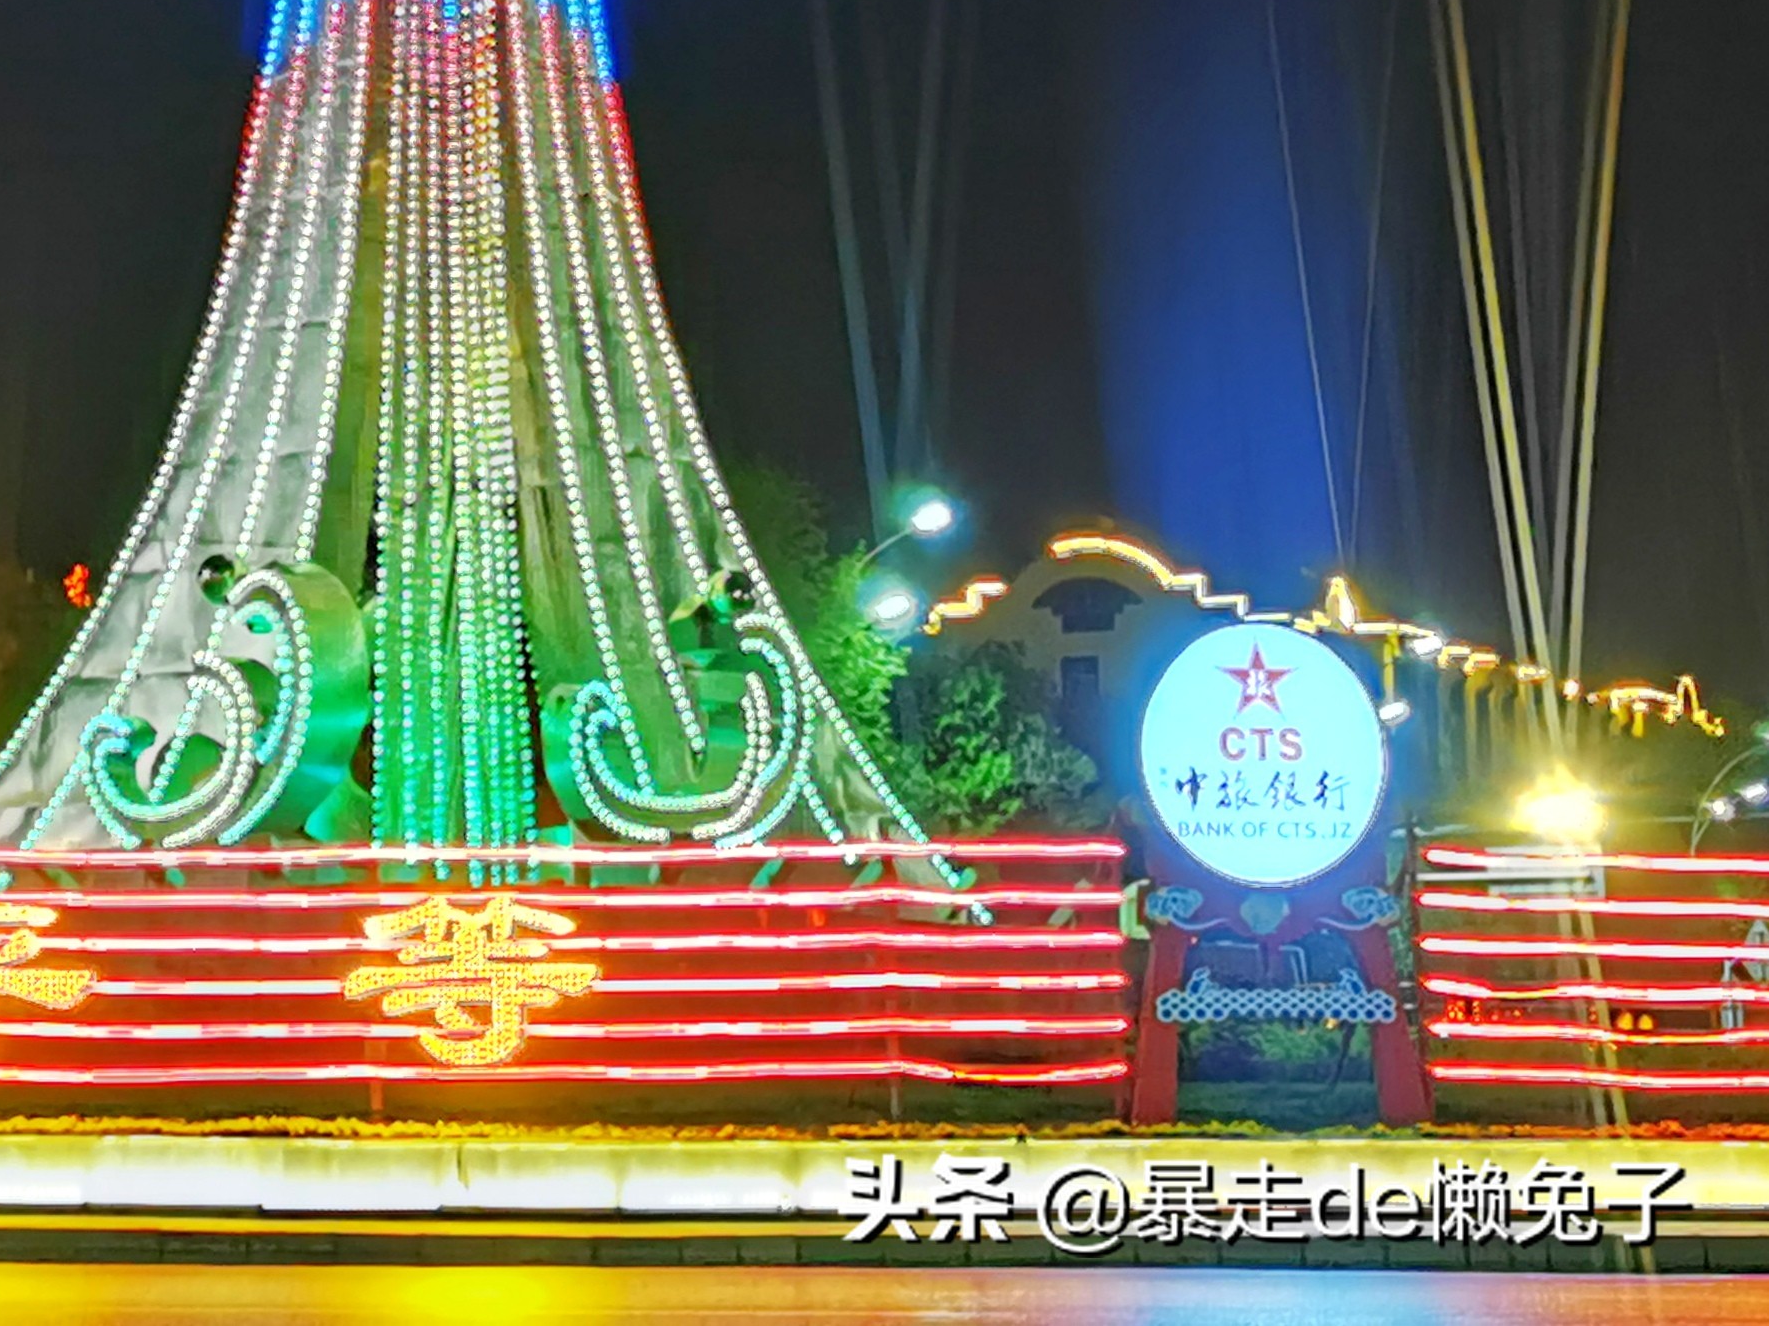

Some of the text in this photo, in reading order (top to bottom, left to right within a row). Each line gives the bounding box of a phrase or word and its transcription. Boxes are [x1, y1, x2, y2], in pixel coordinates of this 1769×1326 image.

[1219, 727, 1303, 761] CTS
[1177, 822, 1234, 838] BANK
[1242, 821, 1270, 838] OF
